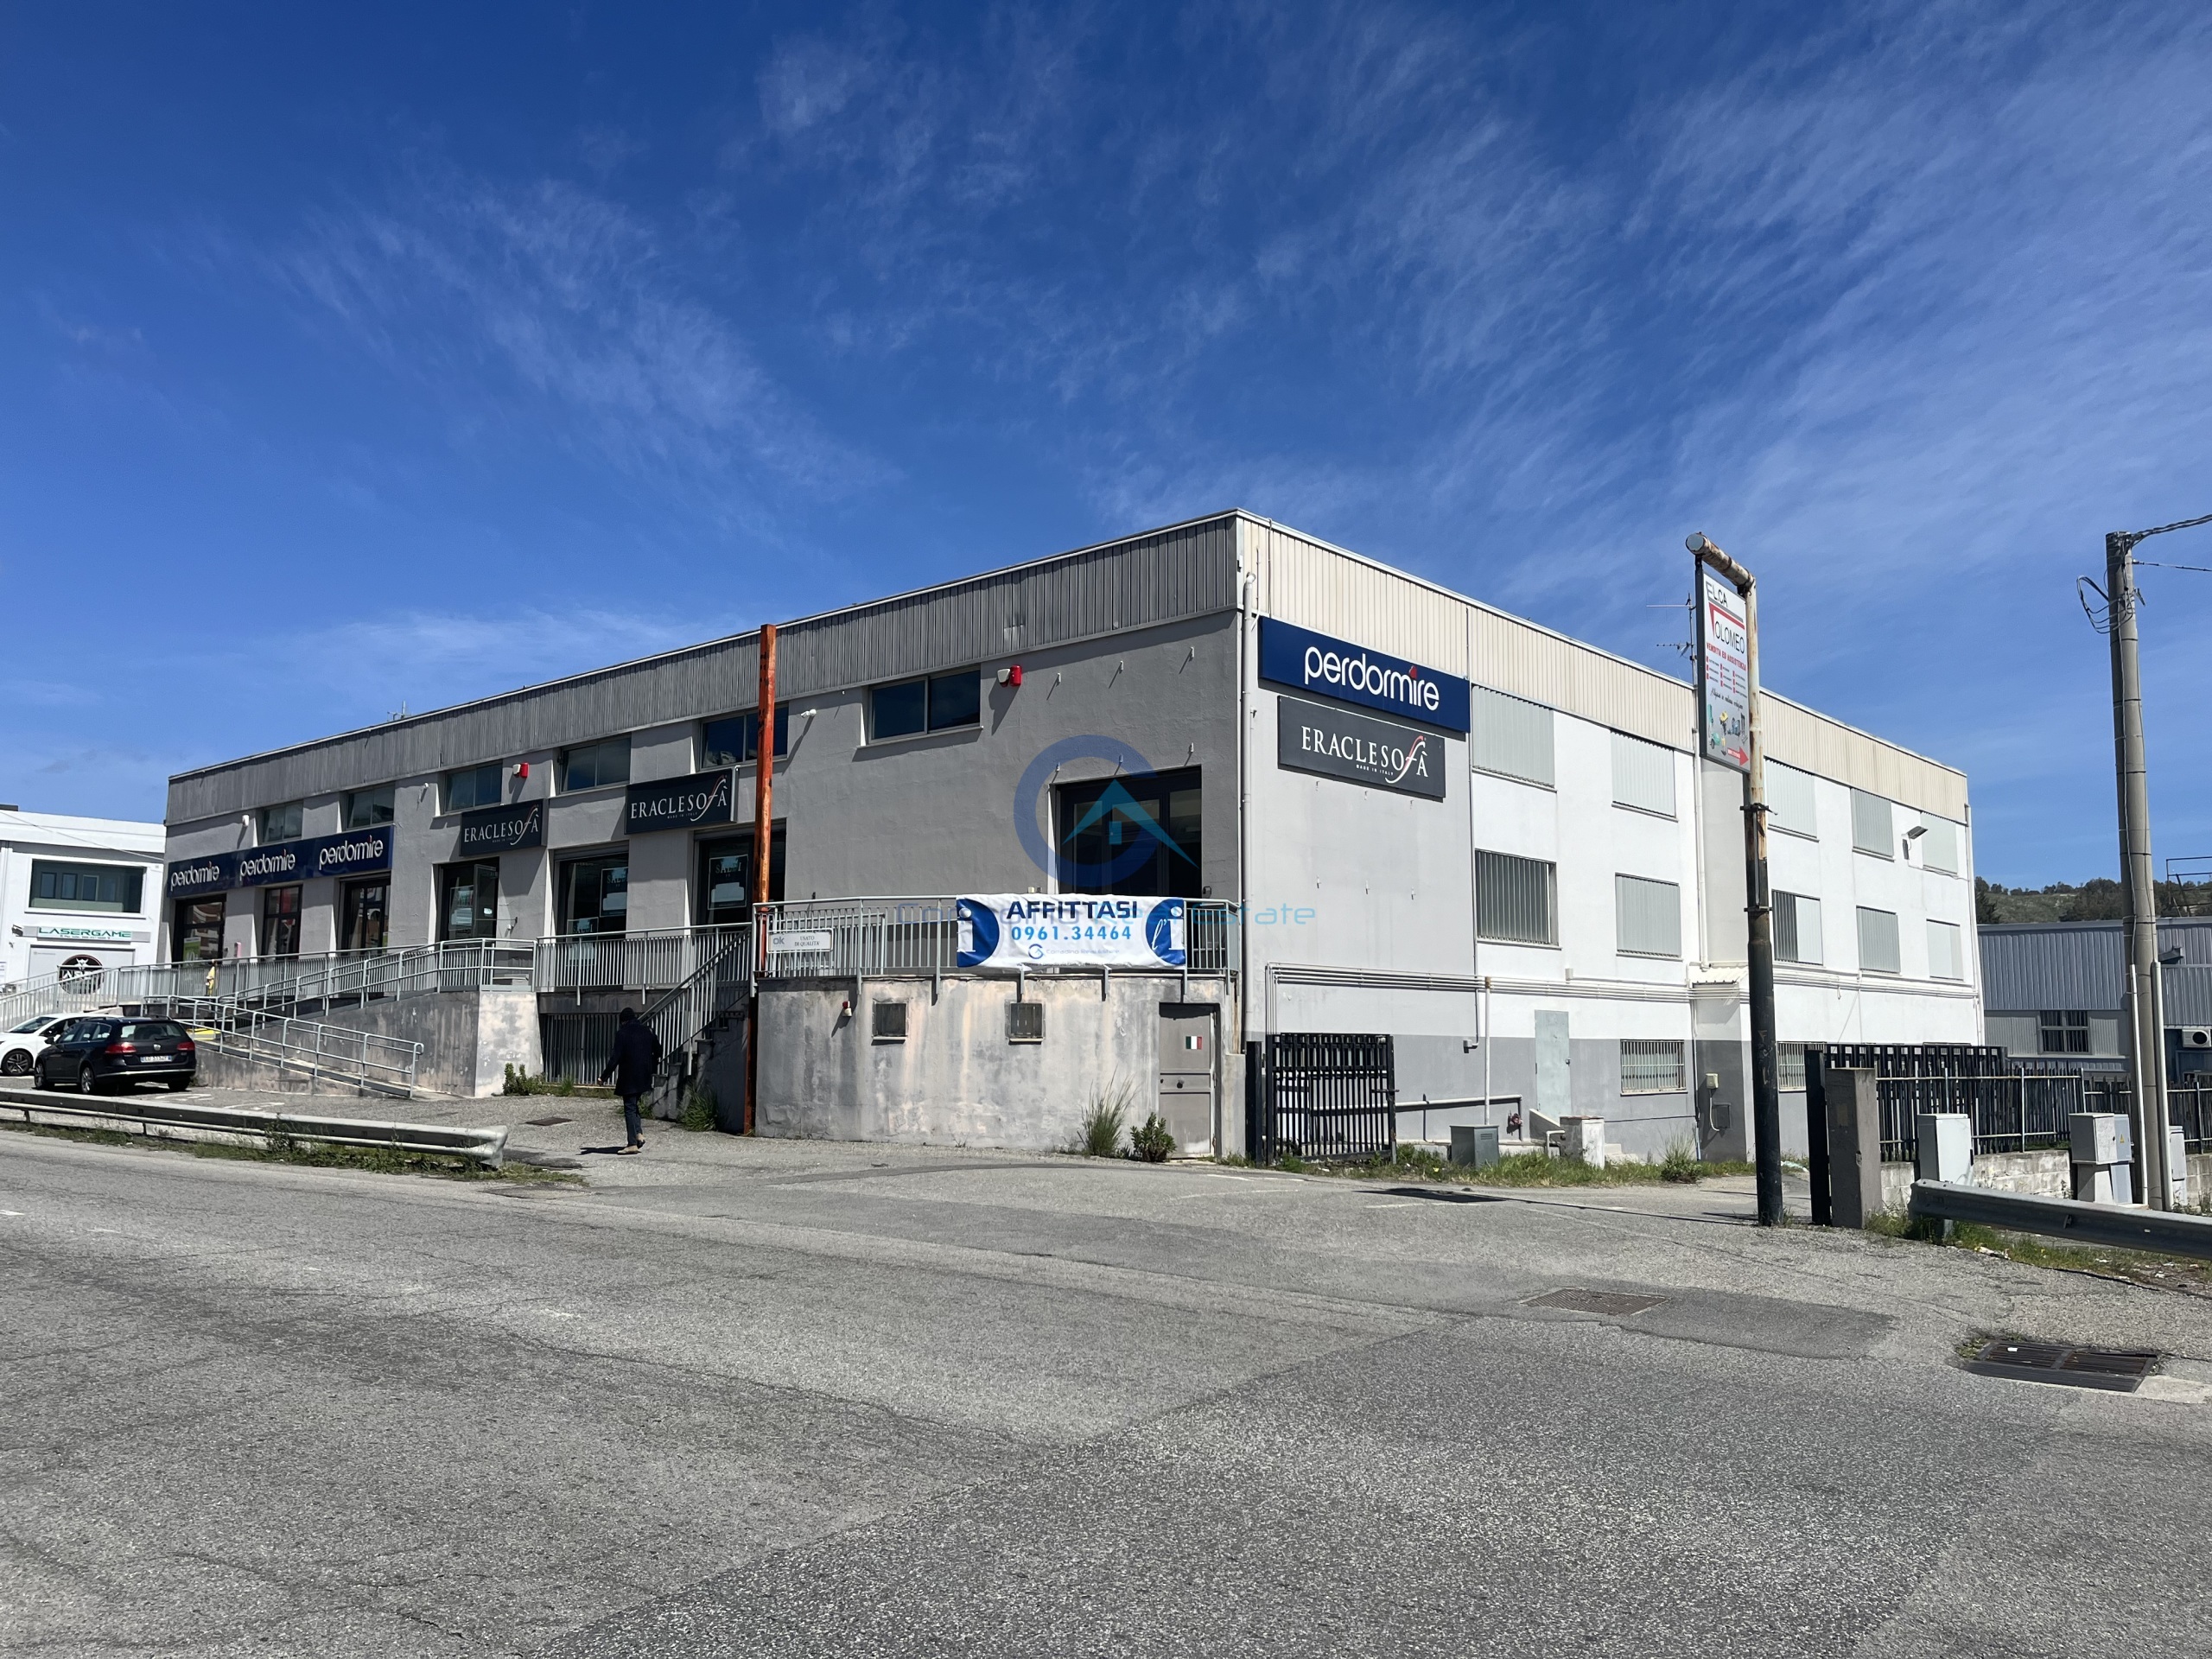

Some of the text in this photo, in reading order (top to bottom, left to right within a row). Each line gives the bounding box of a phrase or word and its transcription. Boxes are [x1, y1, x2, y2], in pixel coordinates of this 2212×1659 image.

[1304, 646, 1440, 711] perdormire
[239, 849, 296, 881] perdormire
[319, 835, 383, 870] perdormire
[170, 861, 219, 892] perdormire
[1007, 901, 1137, 919] AFFITTASI
[39, 926, 131, 938] LASERGAME
[1011, 926, 1132, 941] 0961.34464
